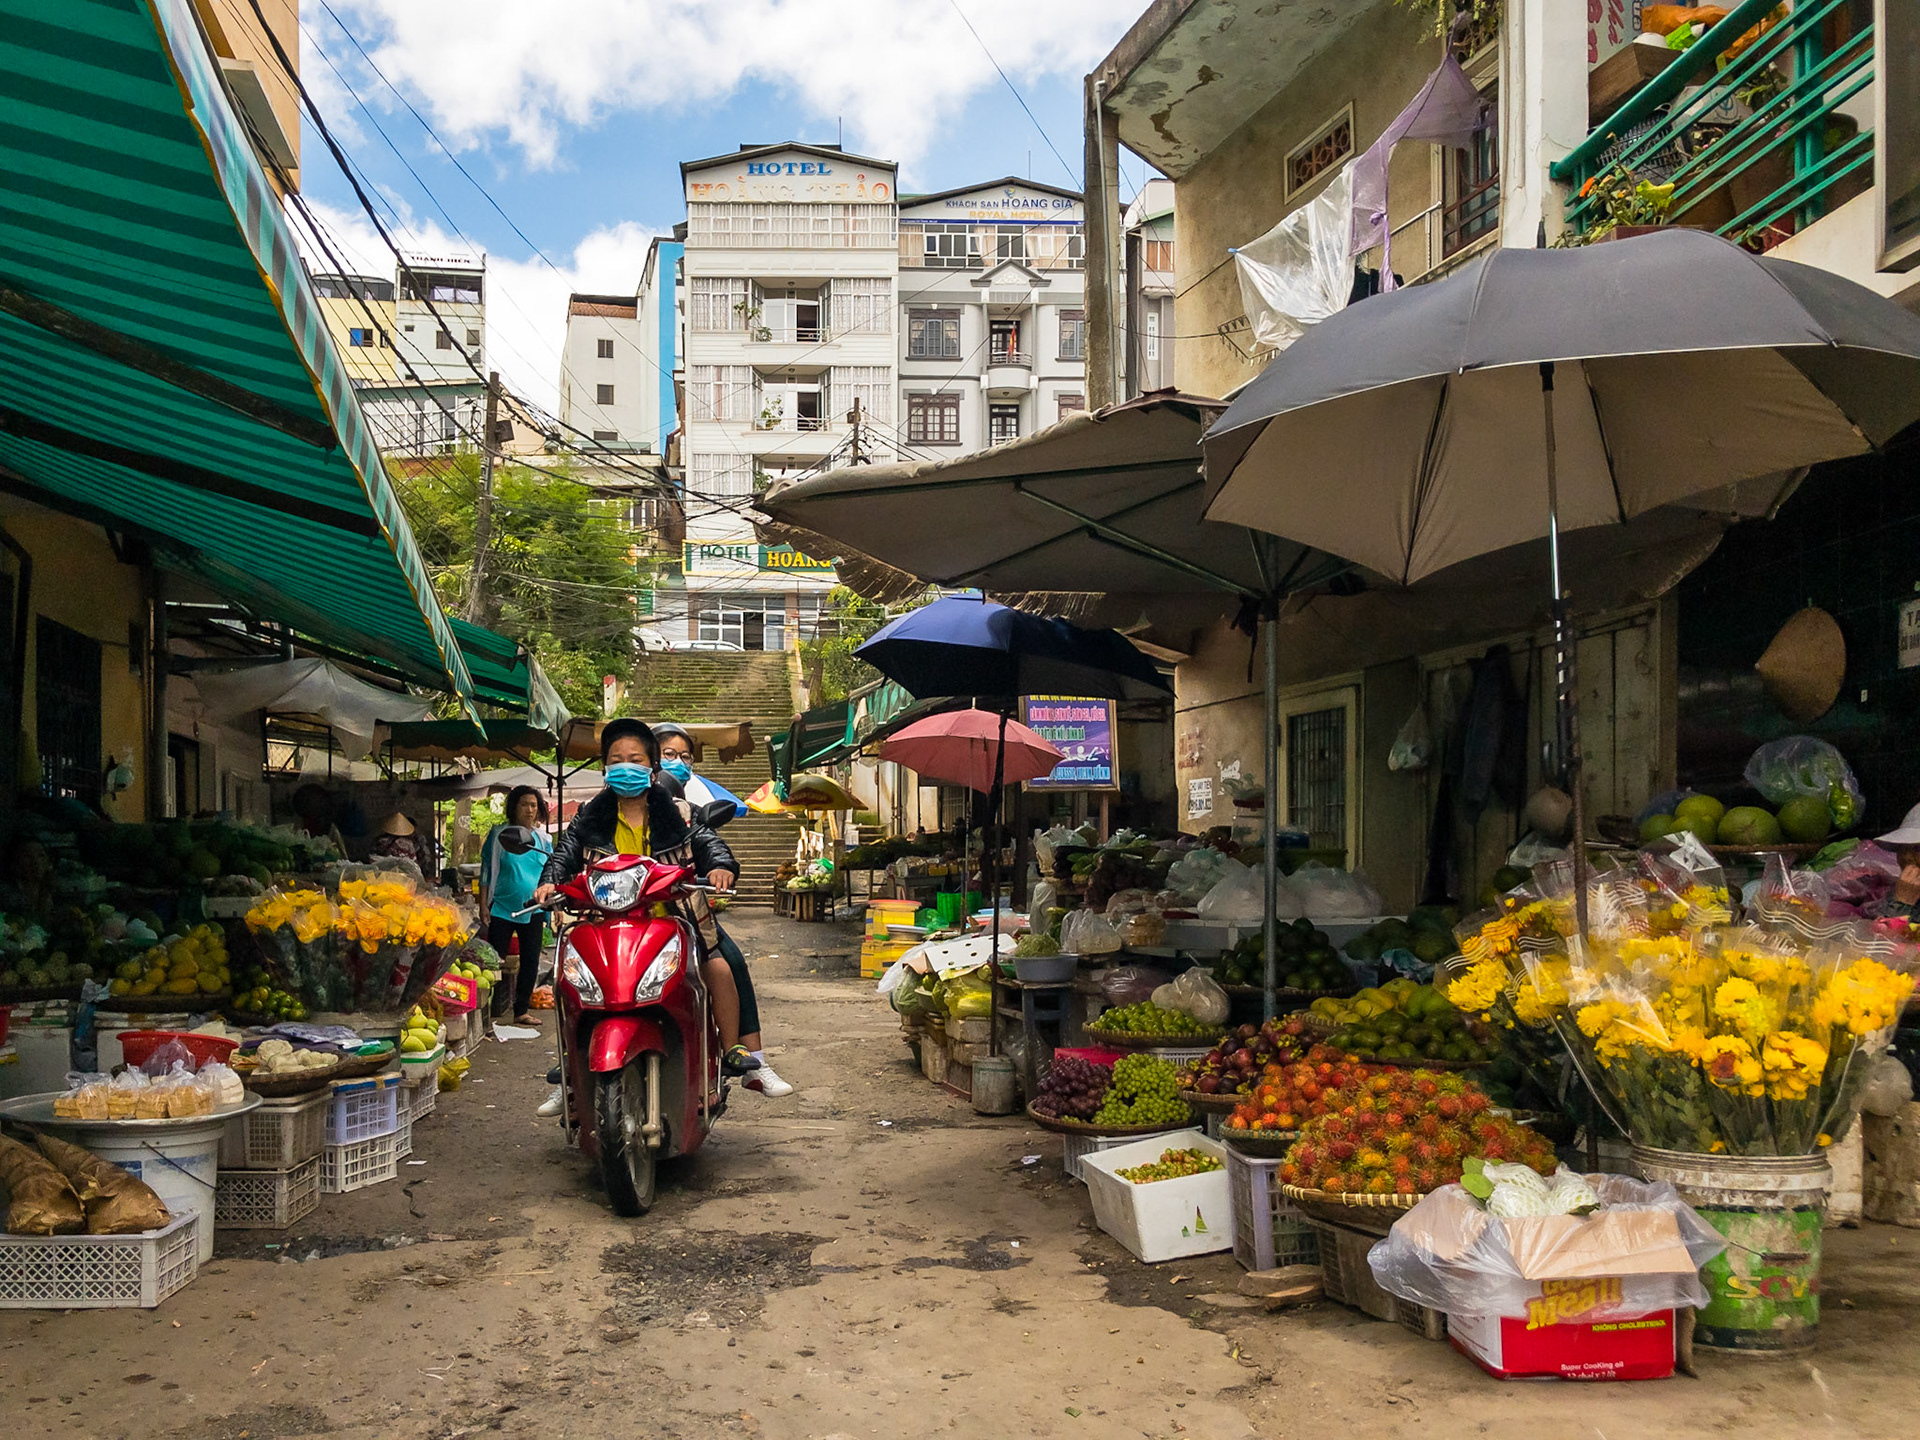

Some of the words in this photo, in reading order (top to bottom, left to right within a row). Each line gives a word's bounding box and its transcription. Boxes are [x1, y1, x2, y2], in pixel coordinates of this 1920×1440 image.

[747, 162, 832, 176] HOTEL
[1052, 199, 1073, 209] GIA
[969, 210, 1007, 219] ROYAL
[1010, 211, 1047, 219] HOTEL
[700, 544, 752, 560] HOTEL
[1561, 1363, 1581, 1371] Super
